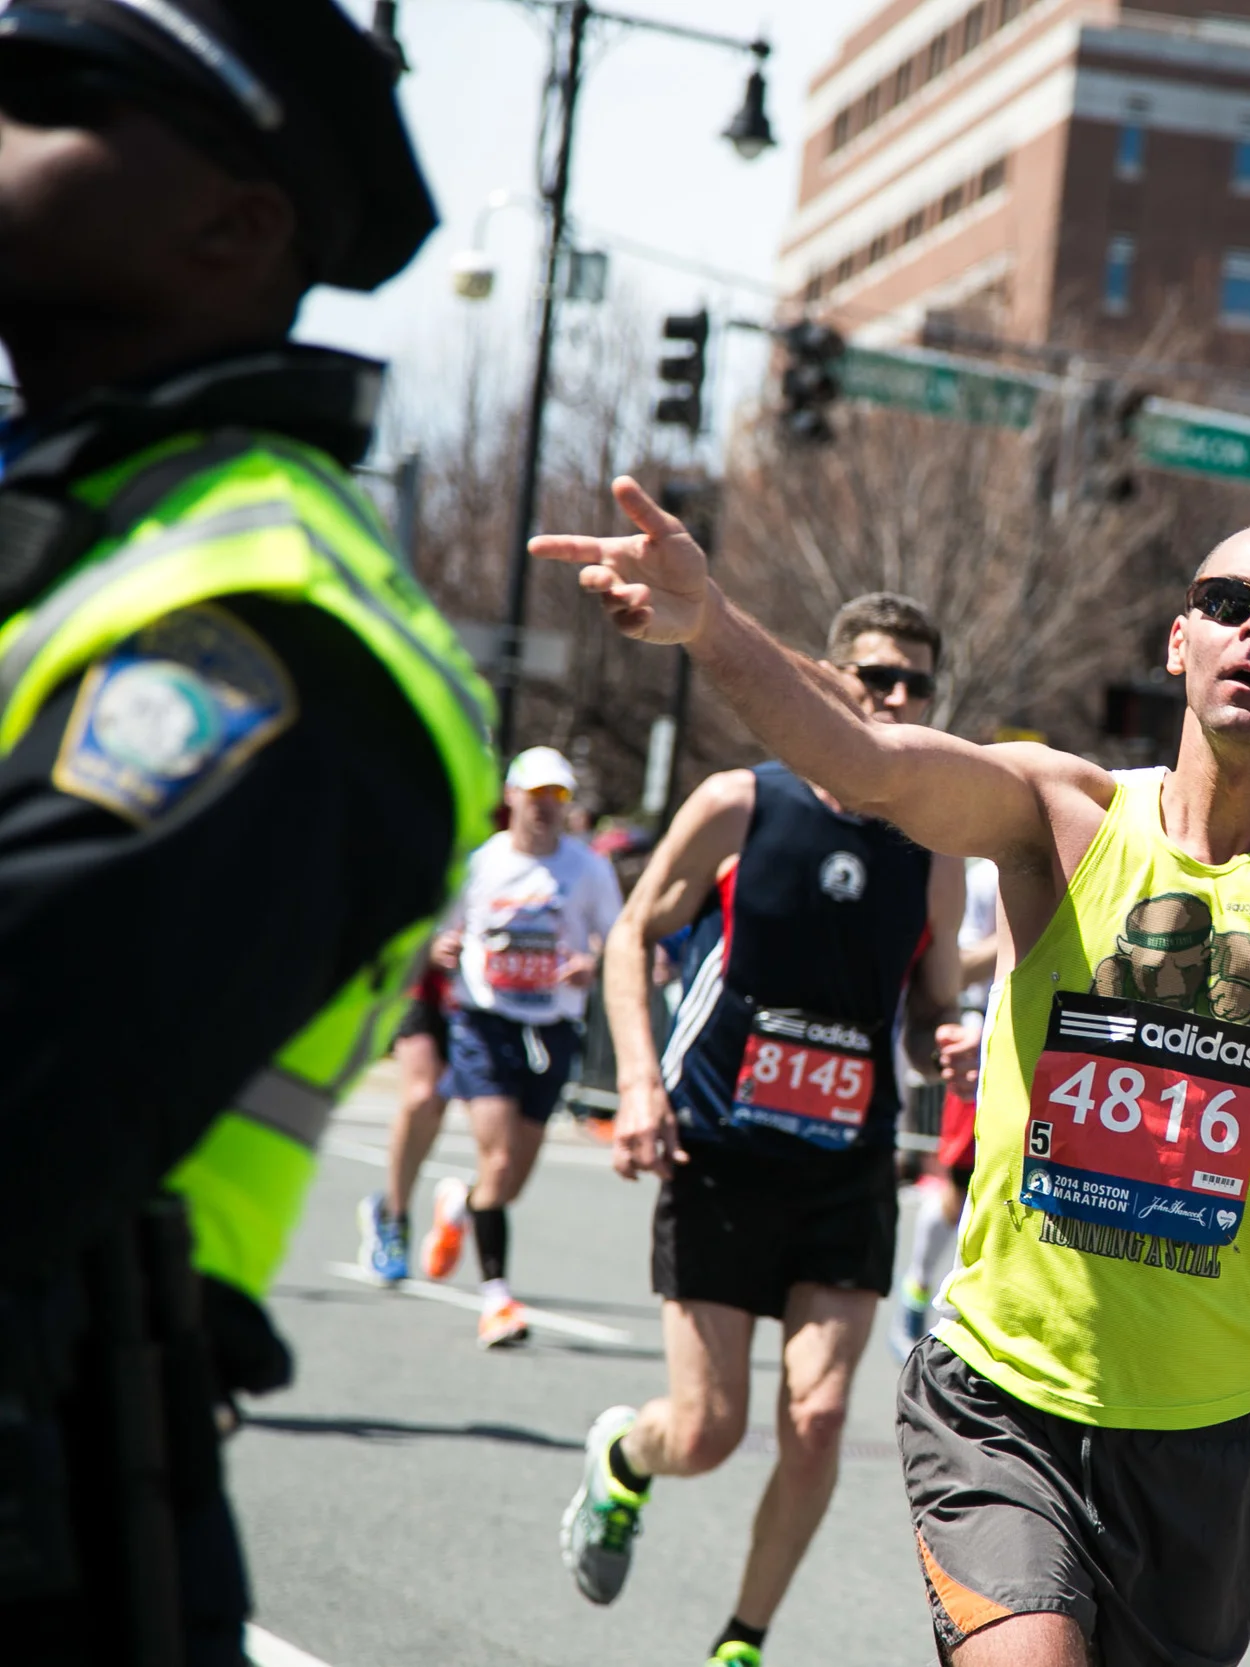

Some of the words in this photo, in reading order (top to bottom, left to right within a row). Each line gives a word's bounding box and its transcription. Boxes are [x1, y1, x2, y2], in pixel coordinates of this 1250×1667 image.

[806, 1023, 872, 1052] adida
[753, 1043, 864, 1099] 8145
[1048, 1061, 1240, 1153] 4816
[1030, 1122, 1050, 1155] 5
[1053, 1187, 1128, 1213] MARATHON
[1055, 1175, 1079, 1189] 2014
[1083, 1182, 1130, 1200] BOSTON
